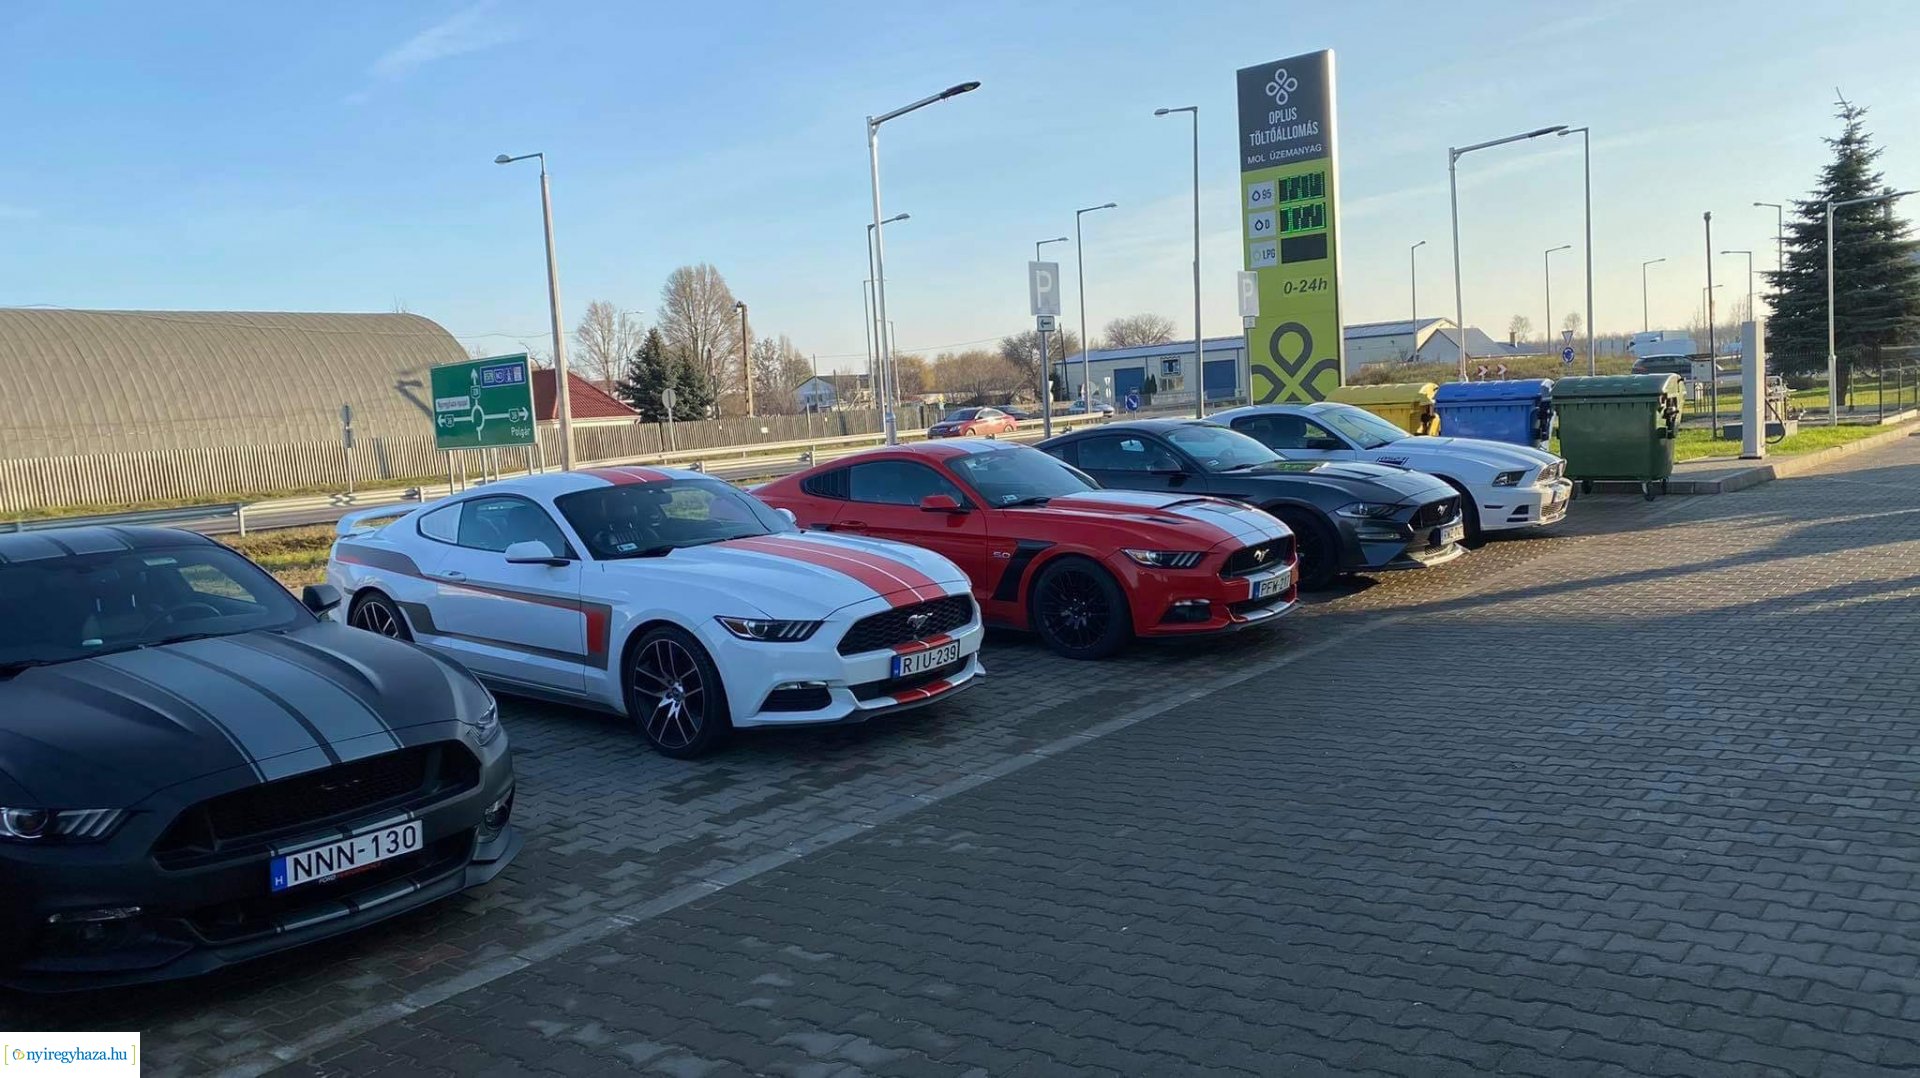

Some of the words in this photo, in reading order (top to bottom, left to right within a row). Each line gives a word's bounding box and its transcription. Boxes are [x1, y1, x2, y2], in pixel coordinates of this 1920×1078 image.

[1269, 107, 1297, 124] OPLUS
[1247, 155, 1266, 164] MOL
[1262, 189, 1272, 200] 95
[1262, 249, 1276, 260] LPG
[1036, 270, 1052, 308] P
[1243, 279, 1254, 310] P
[1284, 278, 1328, 294] 0-24h
[903, 645, 956, 674] RIU-239
[275, 875, 283, 886] H
[293, 825, 416, 882] NNN-130
